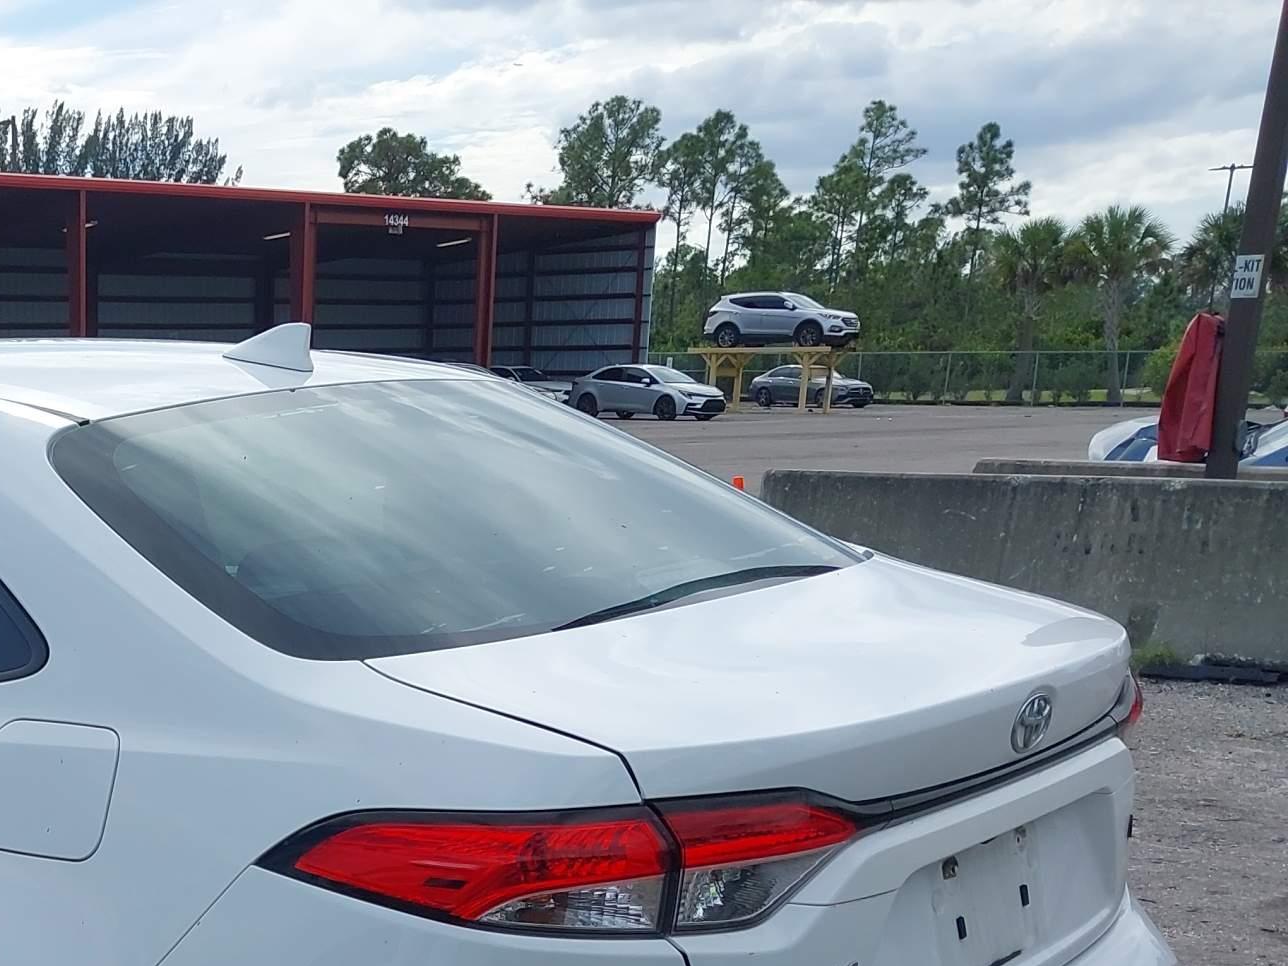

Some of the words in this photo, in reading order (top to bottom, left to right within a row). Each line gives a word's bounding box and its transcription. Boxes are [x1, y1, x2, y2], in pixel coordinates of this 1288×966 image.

[383, 214, 409, 227] 14344
[1234, 259, 1262, 272] -KIT
[1233, 277, 1255, 290] ION
